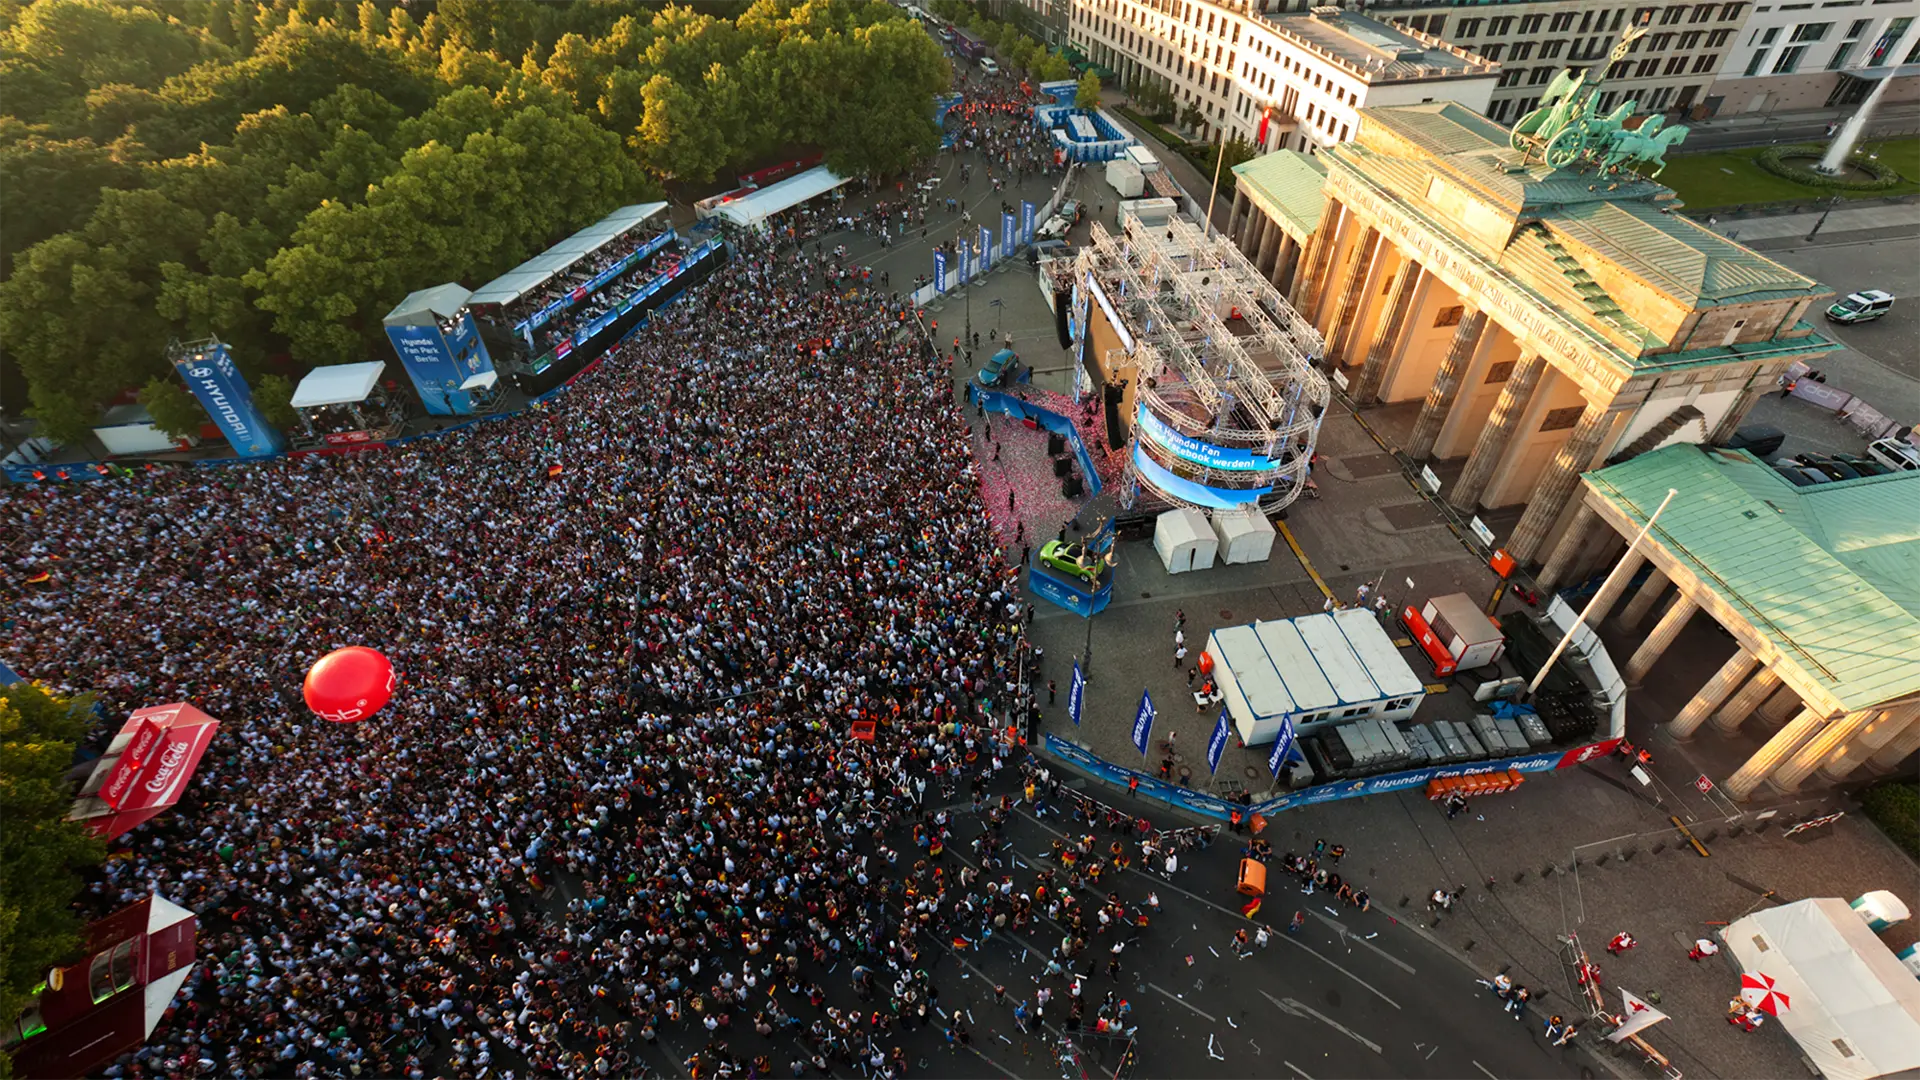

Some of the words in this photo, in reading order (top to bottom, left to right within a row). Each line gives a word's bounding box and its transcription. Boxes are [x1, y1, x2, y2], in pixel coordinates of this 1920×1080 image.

[400, 338, 434, 347] Hyundai
[404, 346, 420, 354] Fan
[421, 346, 440, 354] Park
[414, 355, 440, 363] Berlin
[201, 379, 250, 436] HYUNDAI
[1164, 427, 1199, 451] Hyundai
[1202, 446, 1220, 457] Fan
[1167, 439, 1210, 463] Facebook
[1213, 459, 1256, 469] werden!
[131, 728, 153, 761] Coca-Cola
[108, 763, 132, 798] Coca-Cola
[145, 740, 189, 793] Coca-Cola
[1374, 773, 1429, 788] Hyundai
[1434, 770, 1460, 779] Fan
[1464, 765, 1496, 775] Park
[1508, 758, 1549, 770] Berlin
